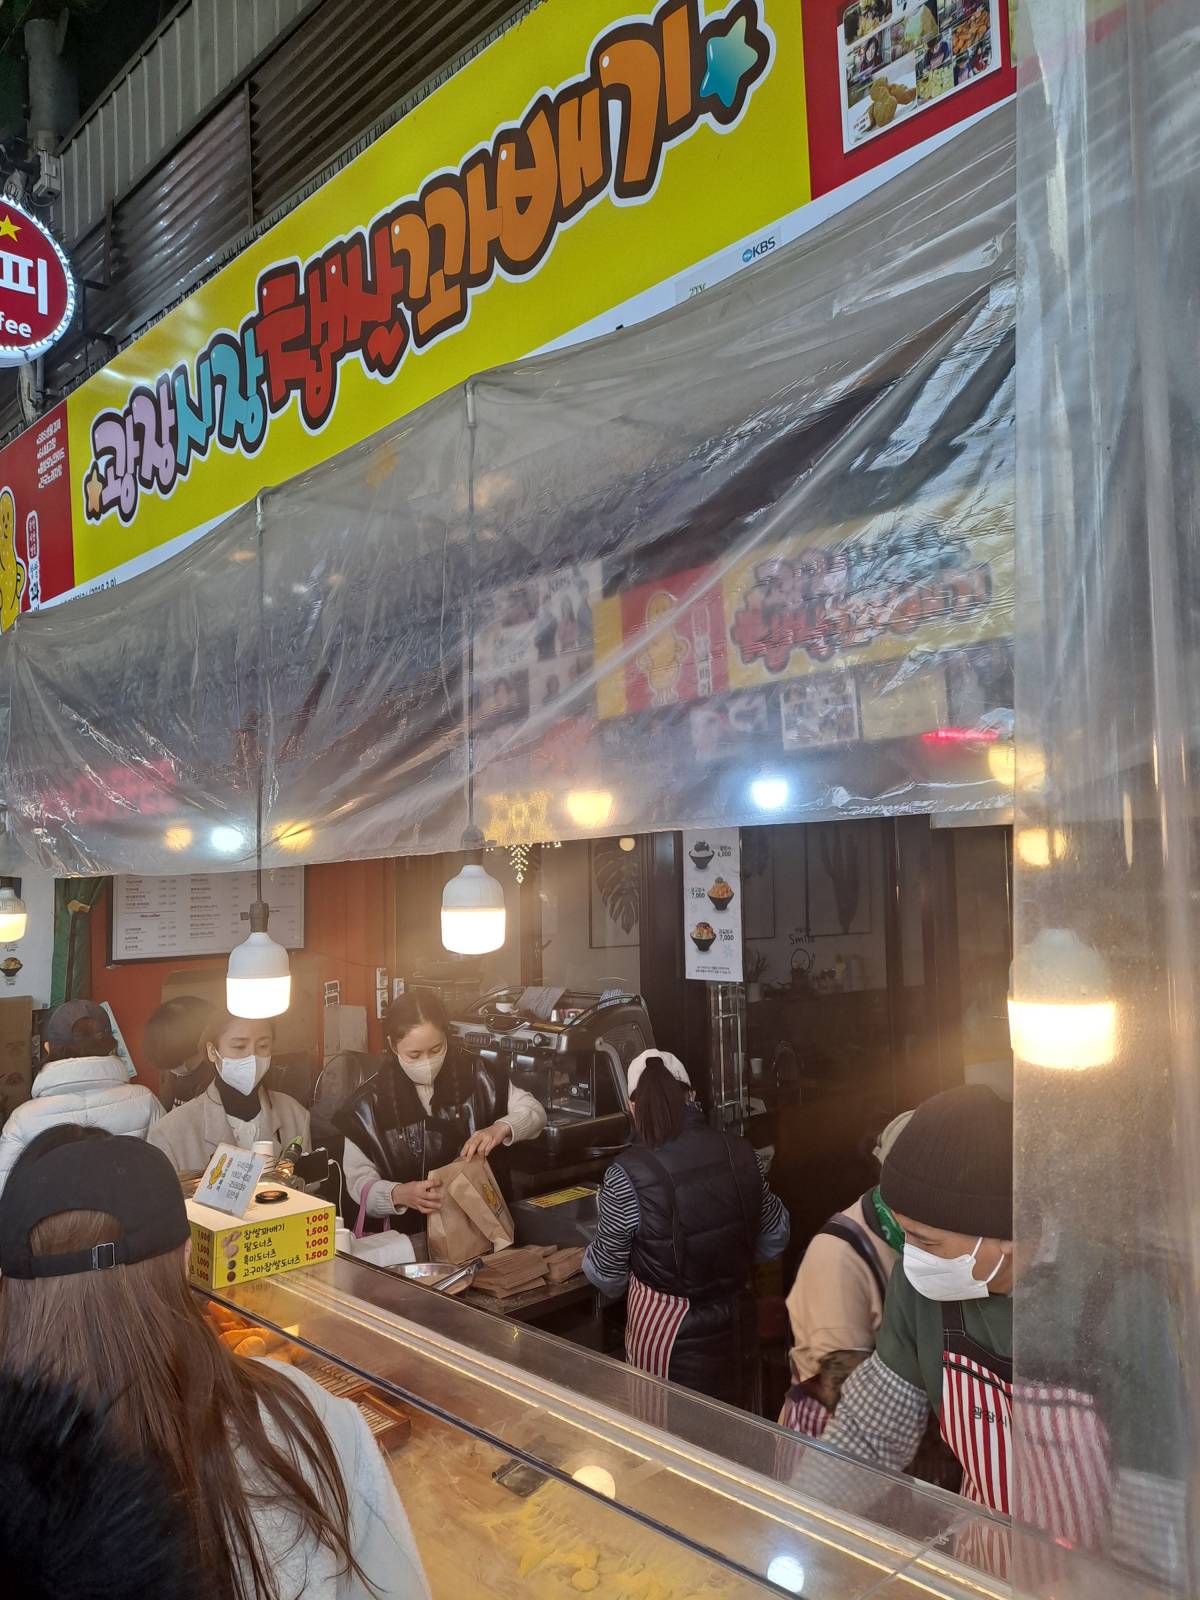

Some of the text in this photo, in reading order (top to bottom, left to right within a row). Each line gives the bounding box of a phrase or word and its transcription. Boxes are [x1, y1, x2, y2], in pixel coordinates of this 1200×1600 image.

[752, 236, 776, 257] KBS
[94, 3, 693, 516] 광장시장 찹쌀꽈배기
[243, 1223, 285, 1240] 찹쌀꽈배기
[242, 1255, 301, 1277] 고구마찹쌀도너츠
